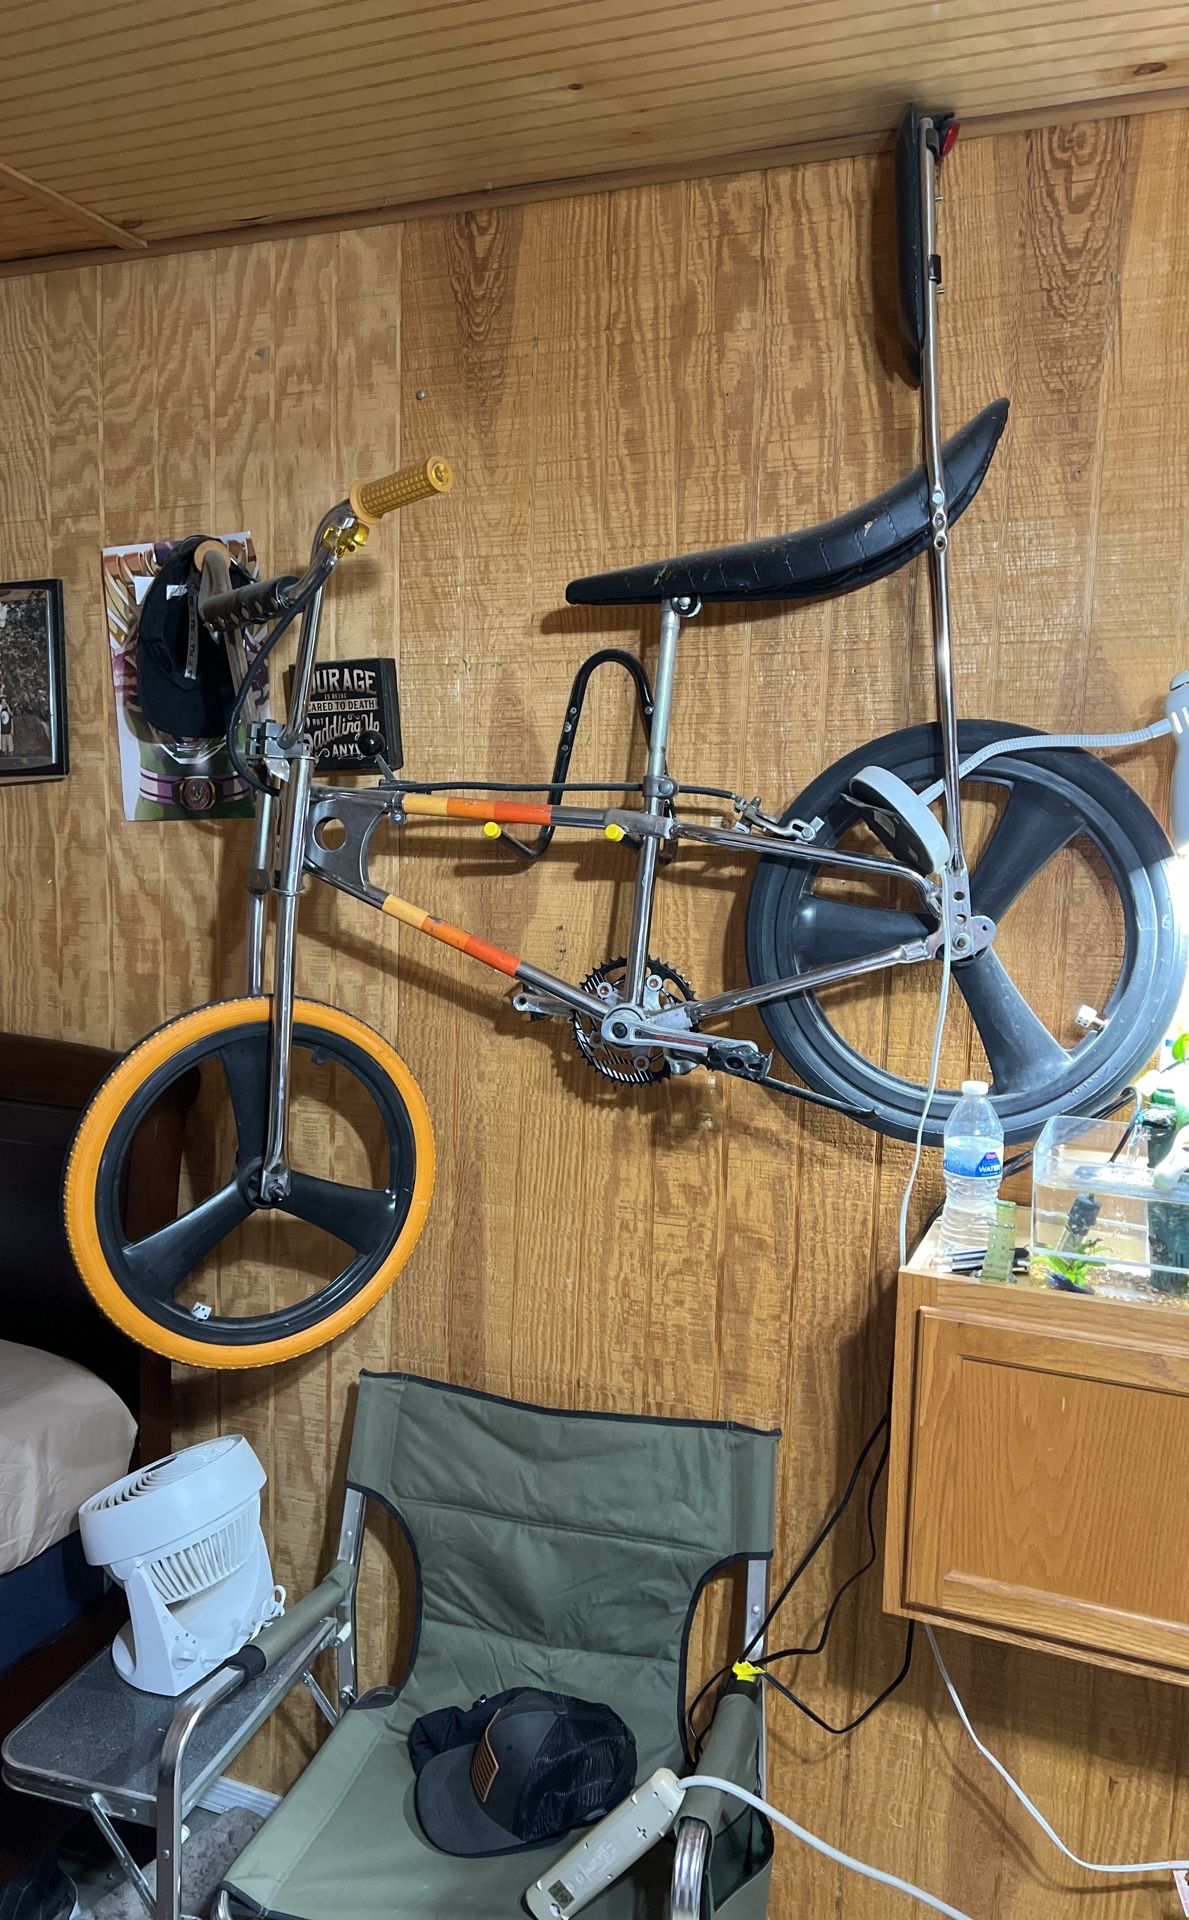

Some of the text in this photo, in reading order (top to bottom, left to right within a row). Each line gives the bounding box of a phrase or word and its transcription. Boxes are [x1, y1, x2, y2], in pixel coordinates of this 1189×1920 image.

[311, 668, 377, 695] URAGE
[308, 699, 375, 713] CARED TO DEATH
[332, 744, 361, 757] ANY
